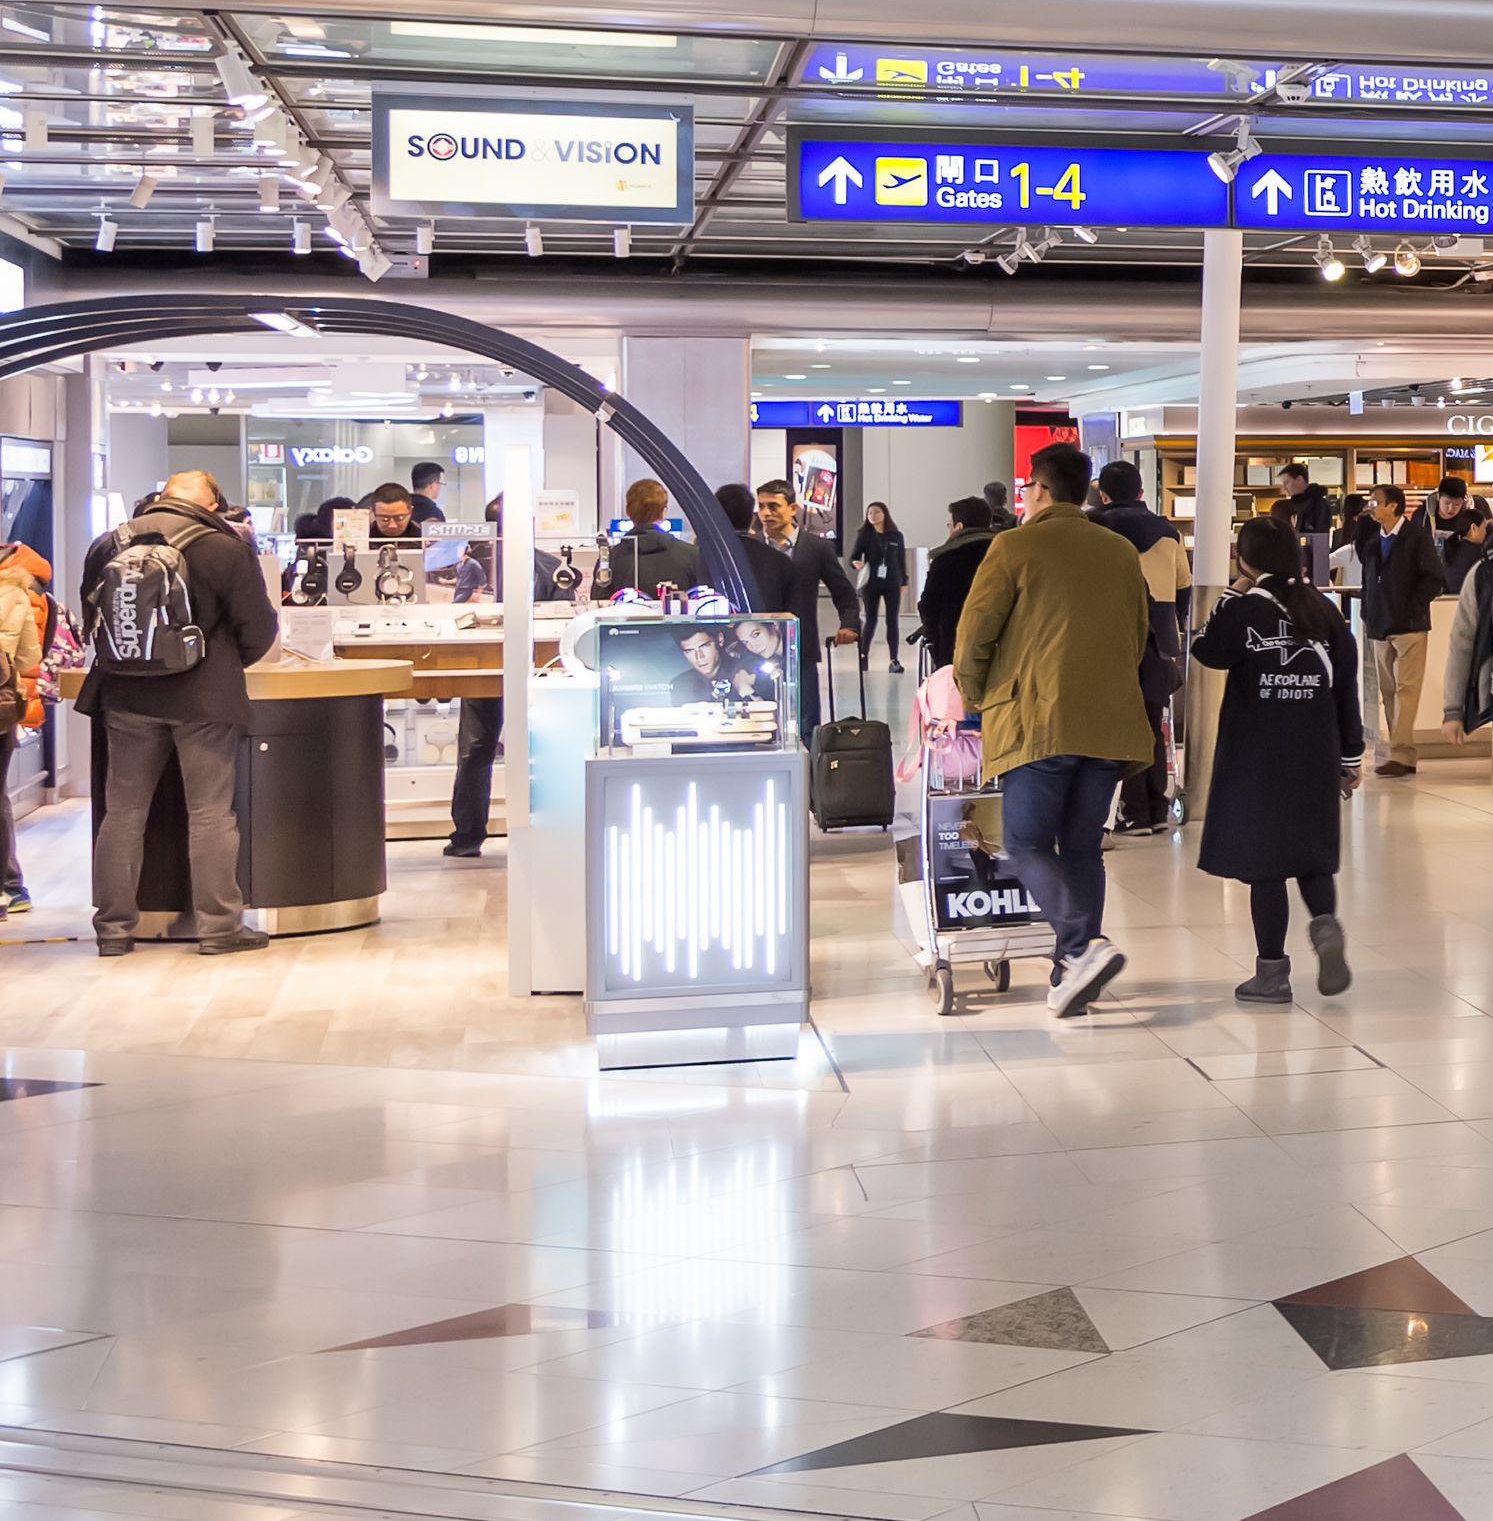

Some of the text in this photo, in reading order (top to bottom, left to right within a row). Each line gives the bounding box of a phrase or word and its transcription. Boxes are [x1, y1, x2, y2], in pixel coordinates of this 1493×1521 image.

[407, 133, 526, 161] SOUND
[530, 138, 552, 163] &
[935, 155, 999, 185] 閘口
[1359, 166, 1489, 197] 熱飲用水
[936, 162, 1086, 210] Gates 1-4
[1359, 198, 1397, 219] Hot
[1402, 199, 1489, 225] Drinking
[429, 525, 490, 536] SHURE
[1259, 673, 1322, 687] AEROPLANE
[1277, 688, 1315, 699] IDIOTS
[939, 821, 967, 831] NEVER
[939, 832, 960, 841] TOO
[947, 889, 1041, 918] KOHL
